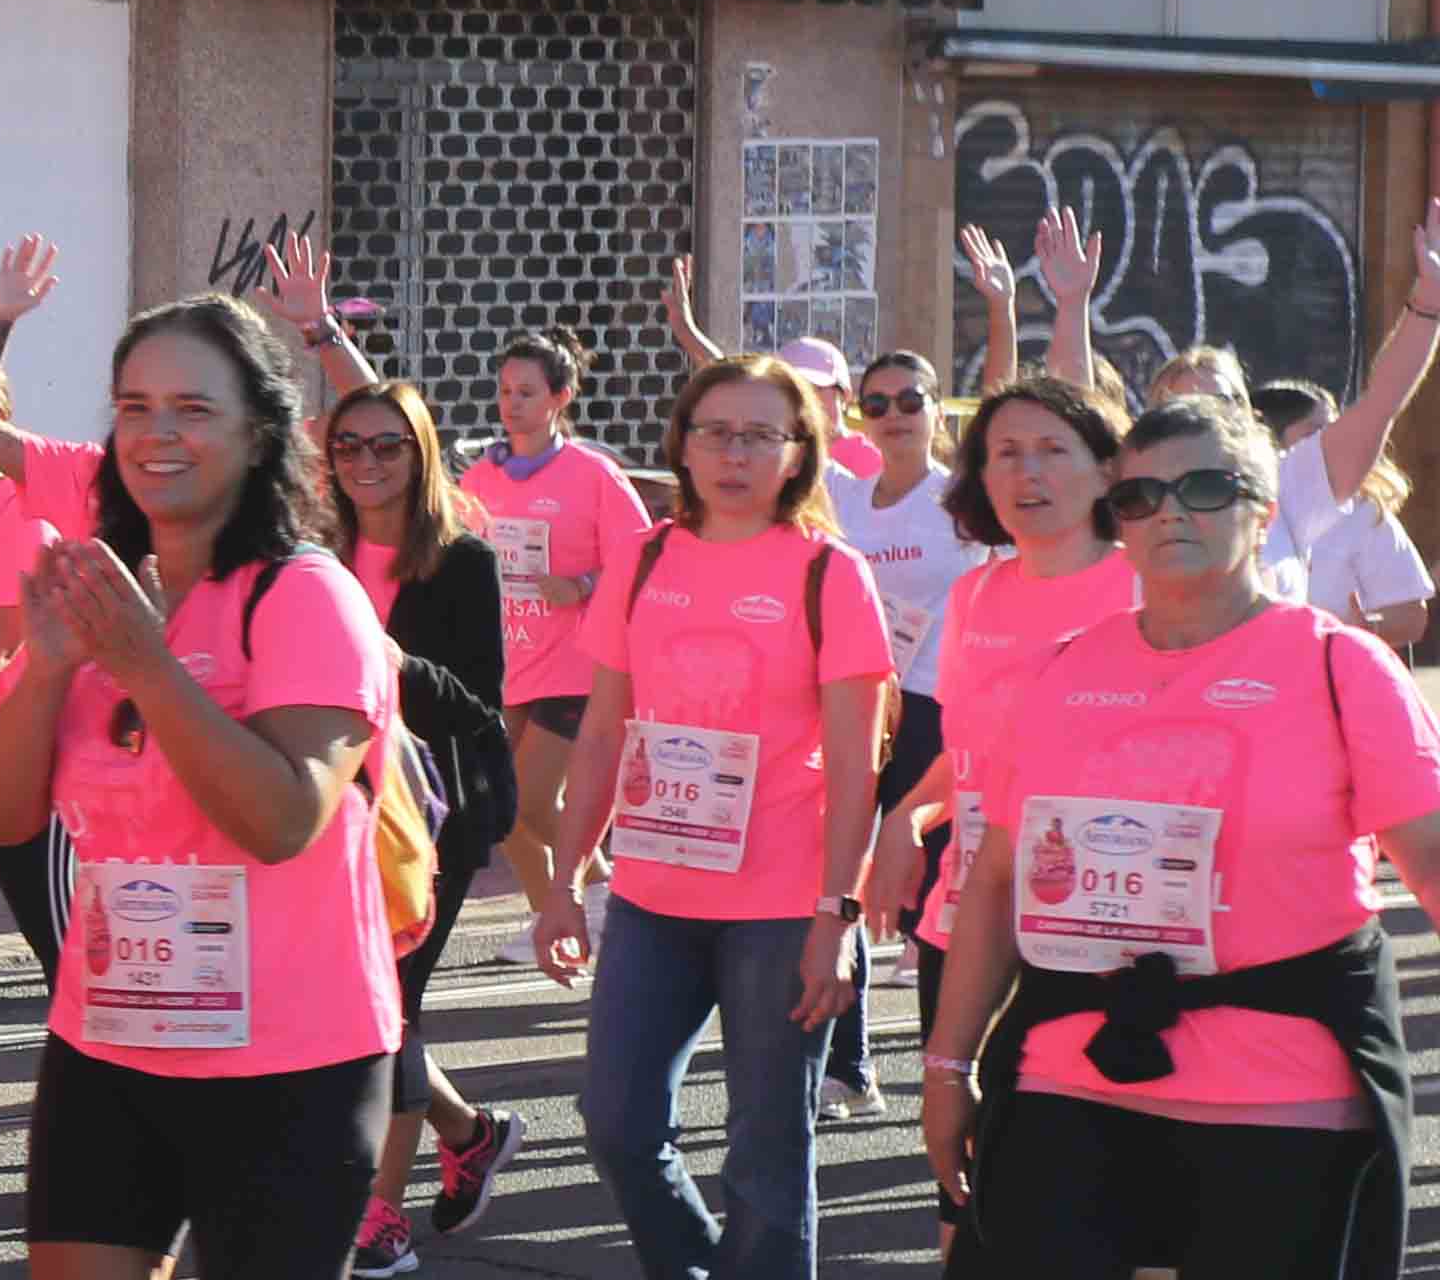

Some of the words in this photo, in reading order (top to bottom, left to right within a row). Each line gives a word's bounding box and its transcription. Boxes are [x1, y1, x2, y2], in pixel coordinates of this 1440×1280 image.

[655, 779, 700, 801] 016
[1082, 869, 1143, 895] 016
[1091, 901, 1129, 918] 5721
[117, 937, 174, 962] 016
